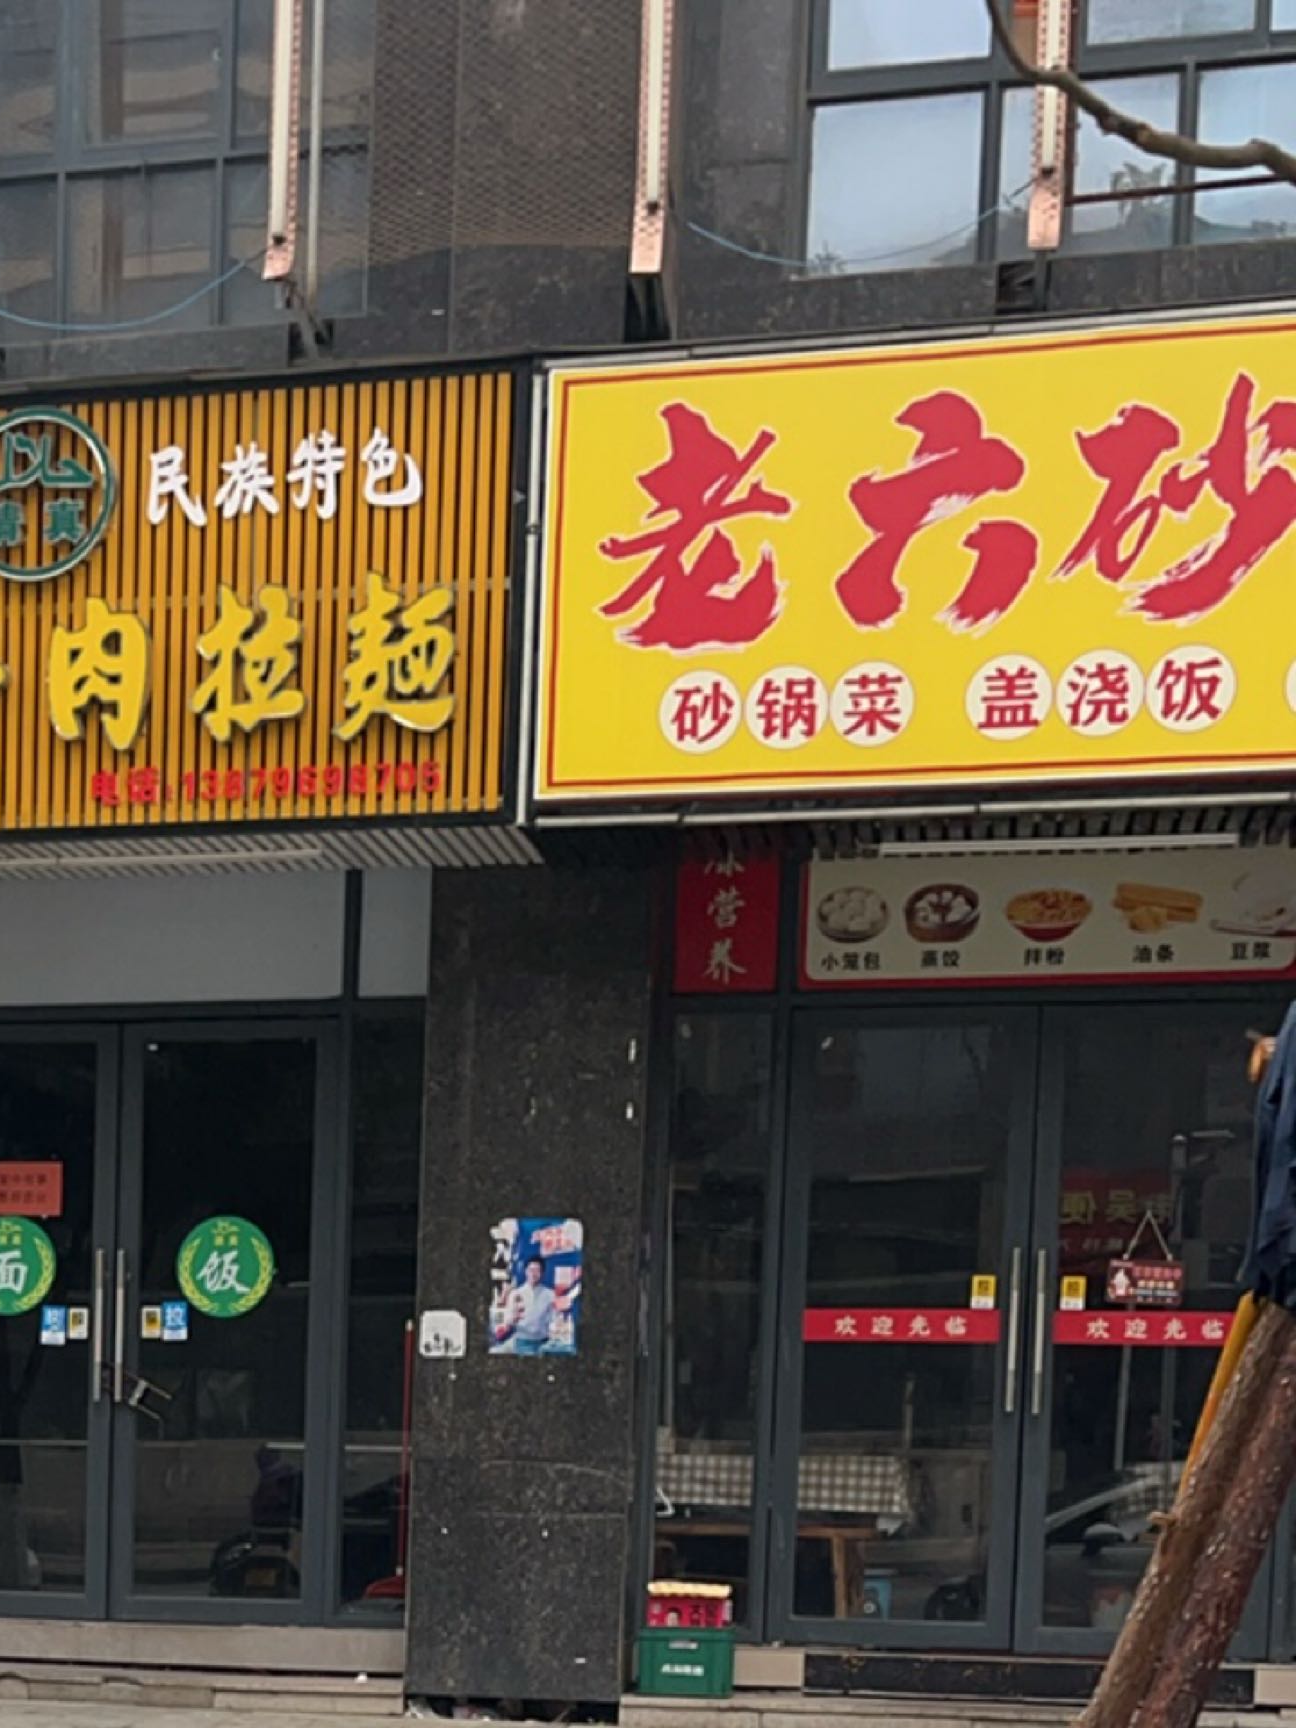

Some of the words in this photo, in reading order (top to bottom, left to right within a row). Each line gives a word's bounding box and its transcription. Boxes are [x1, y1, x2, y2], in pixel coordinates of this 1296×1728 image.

[146, 426, 422, 527] 民族特色
[670, 672, 904, 745] 砂锅菜
[977, 657, 1224, 731] 盖浇饭
[821, 950, 881, 971] 小笼包
[1132, 943, 1174, 963] 油条
[197, 1249, 251, 1294] 饭
[834, 1315, 969, 1337] 欢迎光临
[1086, 1317, 1226, 1341] 欢迎光临
